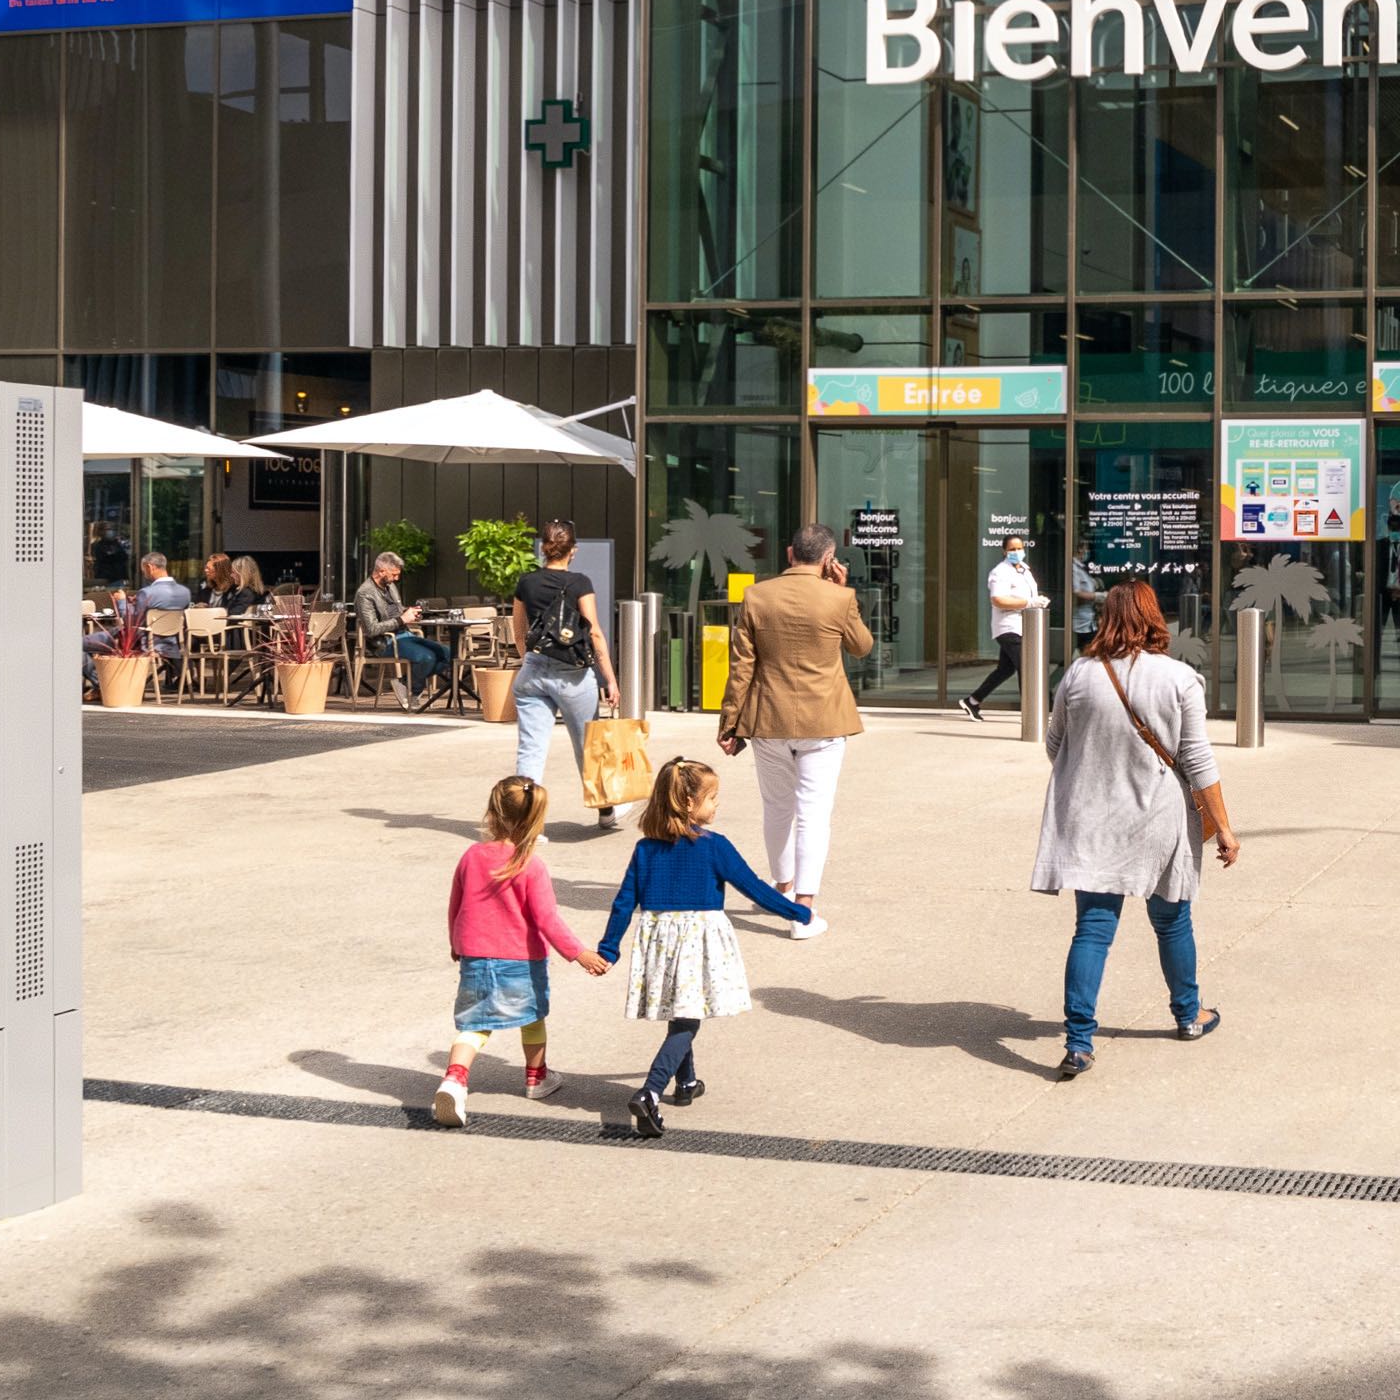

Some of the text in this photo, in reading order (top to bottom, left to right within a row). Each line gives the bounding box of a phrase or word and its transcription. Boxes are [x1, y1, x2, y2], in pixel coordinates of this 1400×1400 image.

[1158, 371, 1195, 394] 100
[903, 382, 982, 404] Entrée
[1313, 428, 1340, 437] VOUS
[1089, 492, 1111, 500] Votre
[860, 512, 895, 524] bonjour
[991, 513, 1027, 525] bonjour
[857, 524, 898, 534] welcome
[988, 525, 1030, 536] welcome
[851, 536, 904, 548] buongiorno
